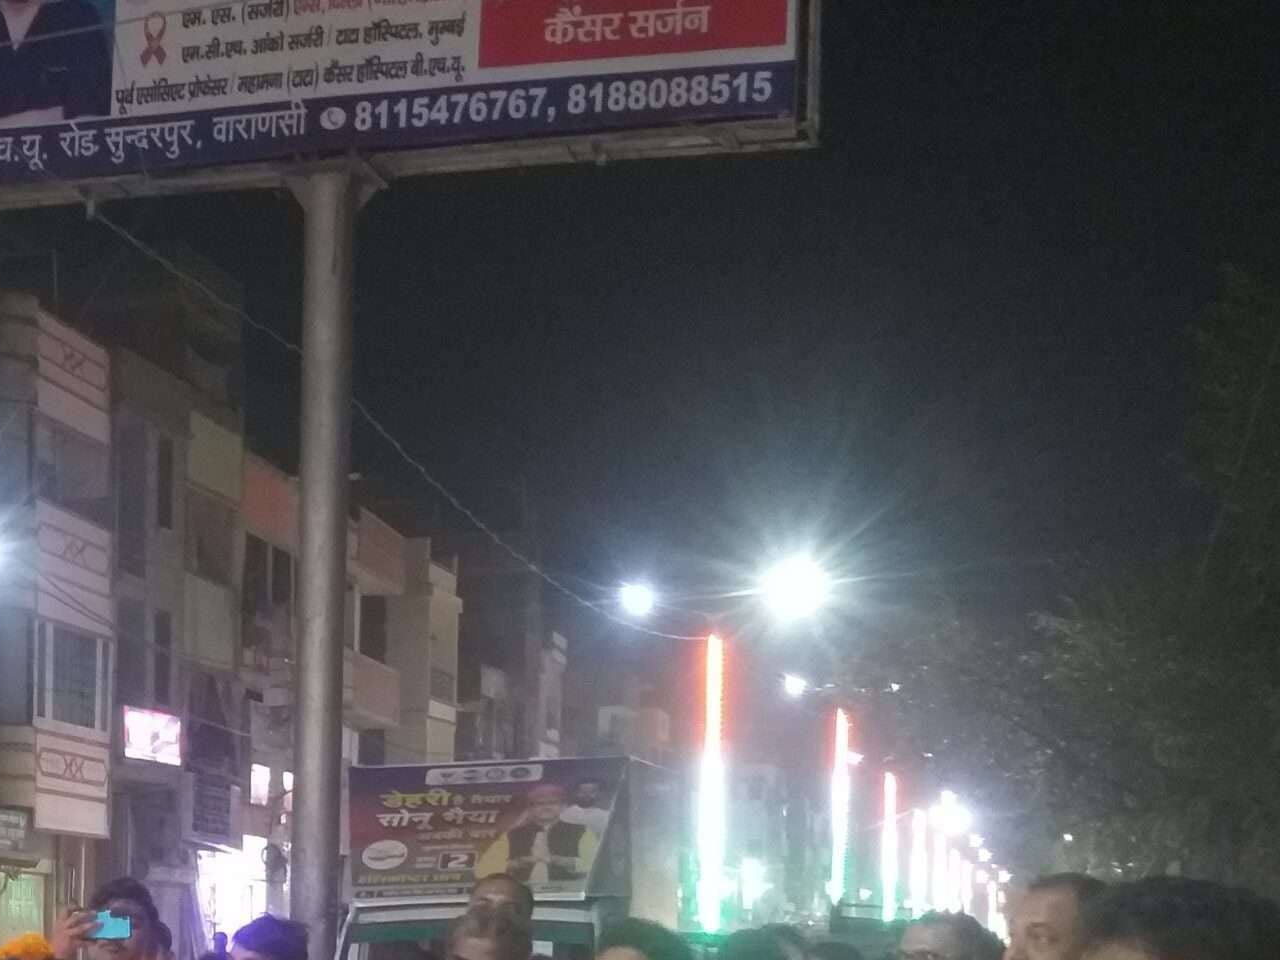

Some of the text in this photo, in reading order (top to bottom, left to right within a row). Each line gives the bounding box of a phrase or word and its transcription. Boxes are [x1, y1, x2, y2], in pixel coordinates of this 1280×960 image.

[543, 0, 712, 45] कैंसर सर्जन
[213, 100, 310, 143] वाराणसी
[354, 87, 556, 131] 8115476767,
[567, 71, 773, 114] 8188088515
[376, 809, 434, 831] सोनू
[448, 853, 468, 868] 2
